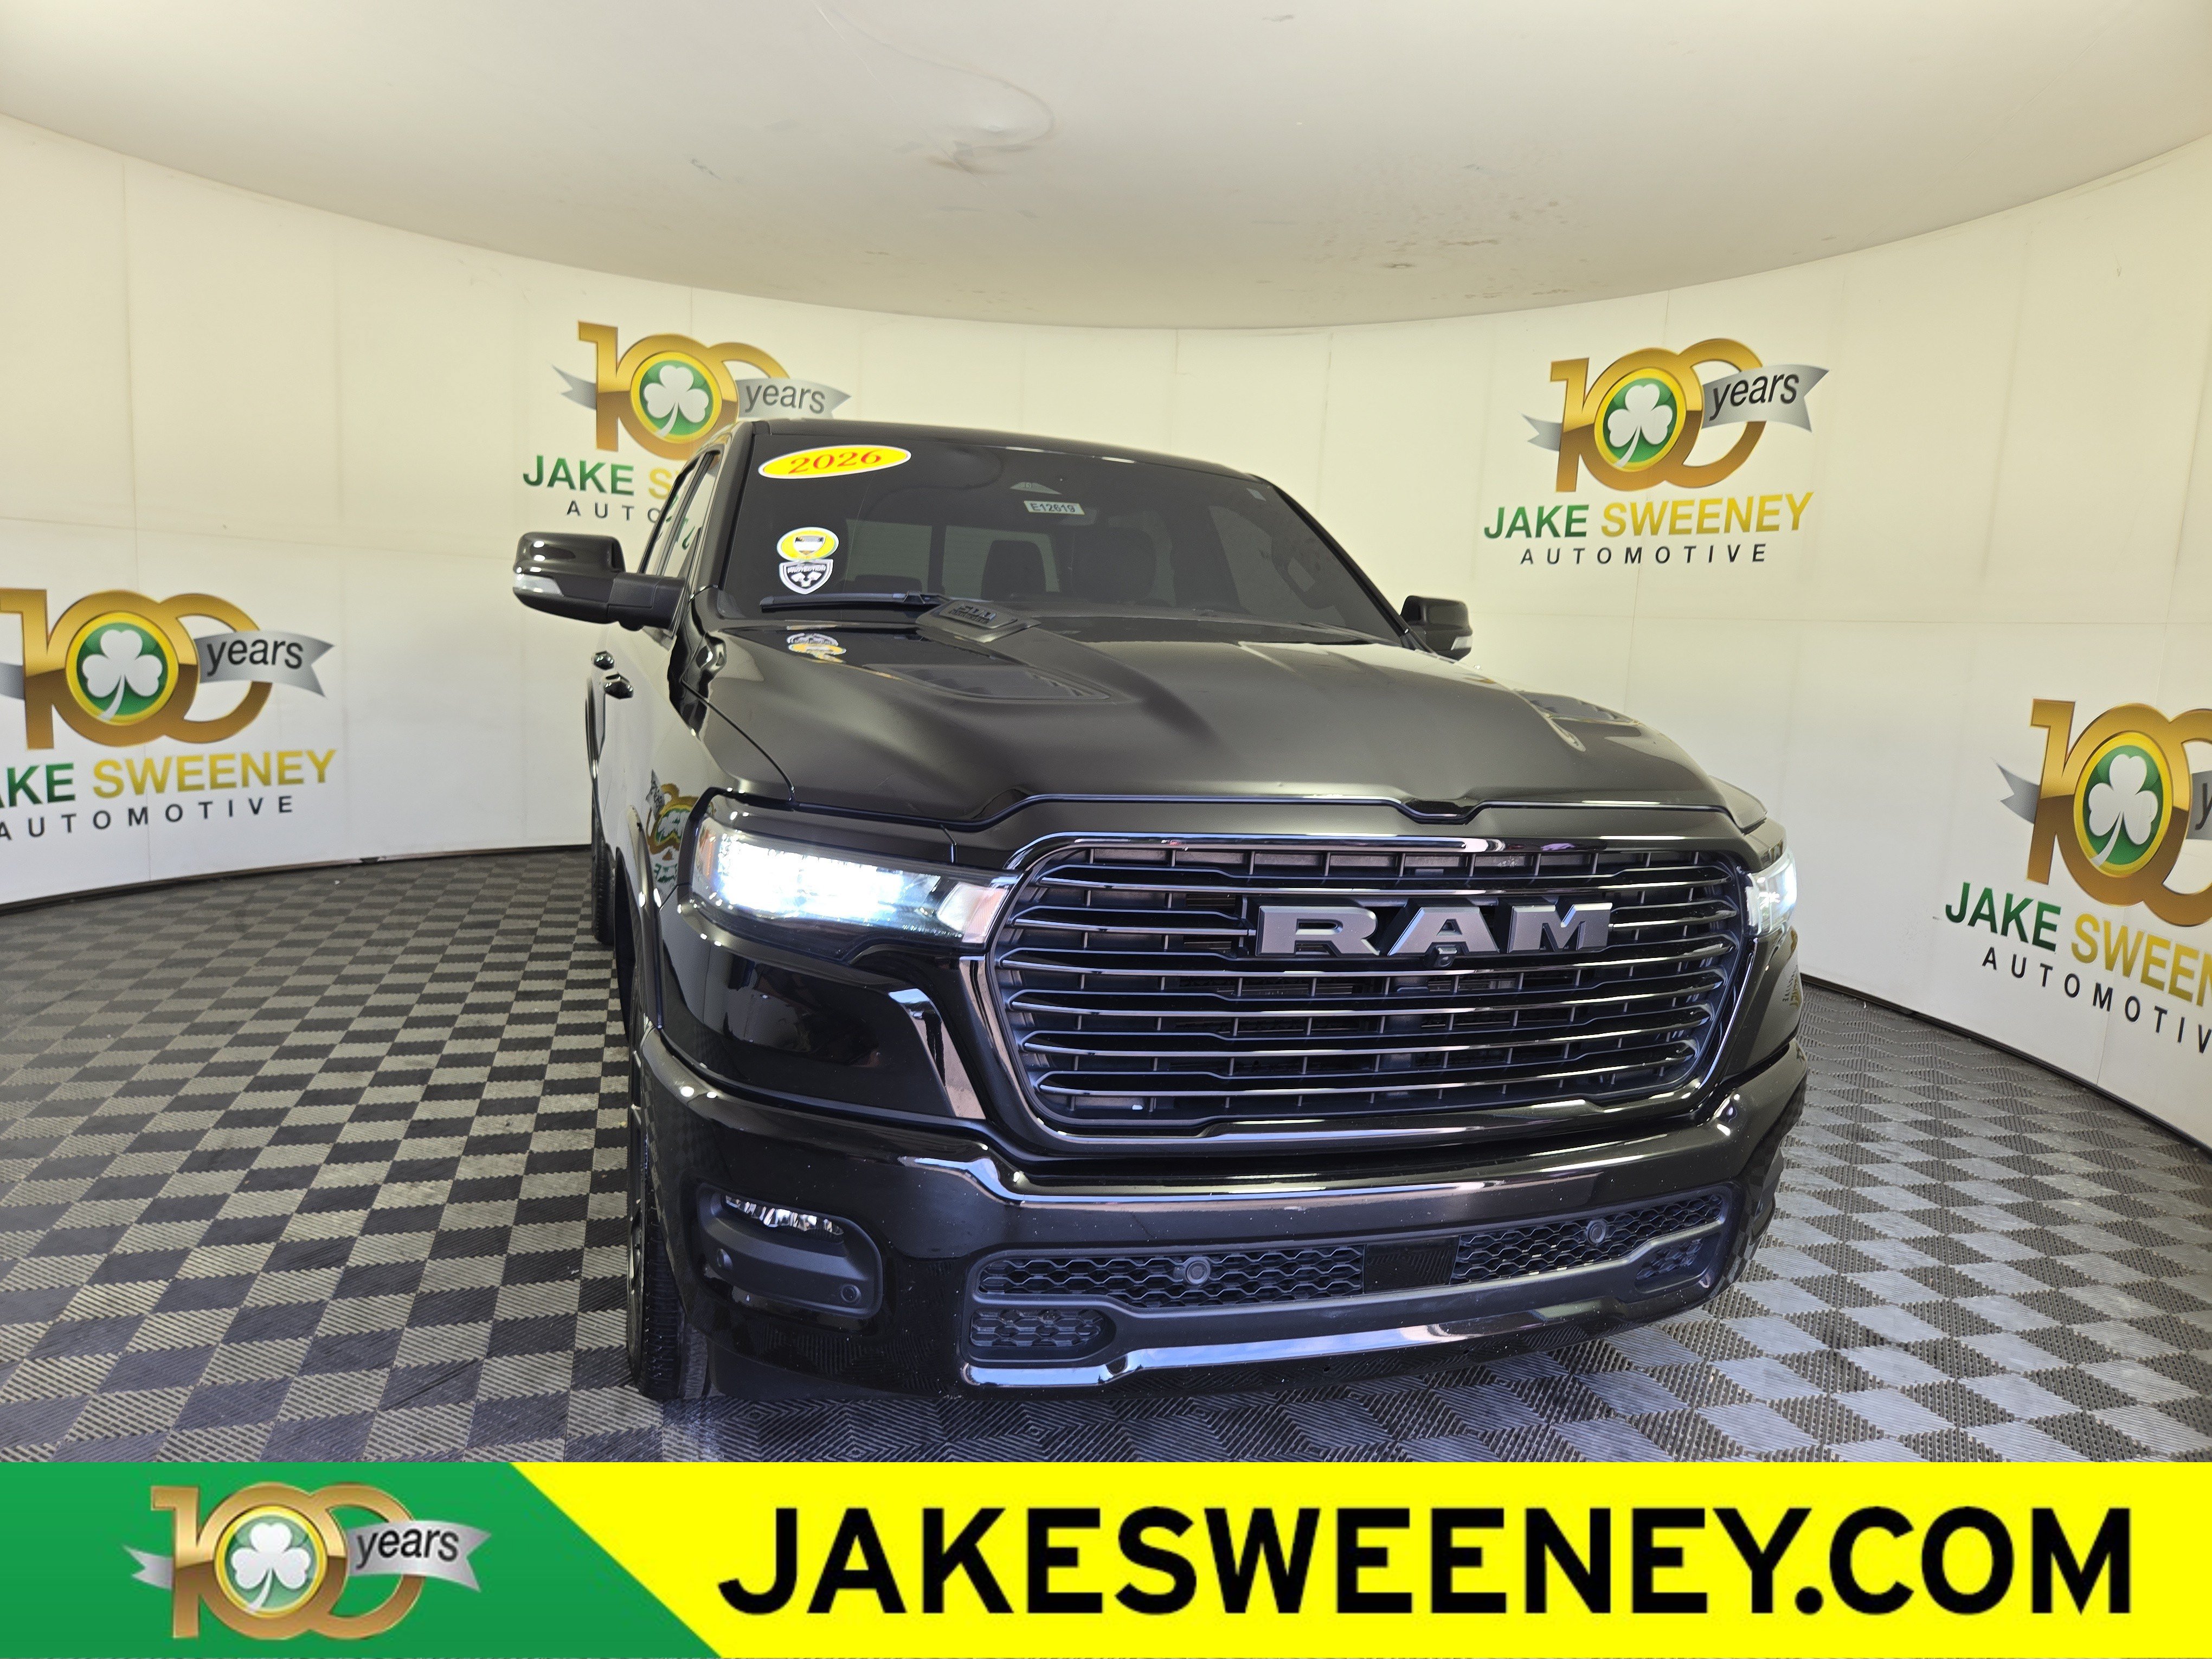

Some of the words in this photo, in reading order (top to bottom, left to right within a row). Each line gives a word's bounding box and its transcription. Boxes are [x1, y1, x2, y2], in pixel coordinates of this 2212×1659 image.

[744, 382, 826, 414] years
[1550, 338, 1767, 492] 100
[1709, 372, 1799, 421] years
[523, 455, 634, 496] JAKE
[788, 449, 883, 474] 2026
[1484, 505, 1590, 539] JAKE
[1601, 492, 1814, 538] SWEENEY
[1520, 544, 1767, 565] AUTOMOTIVE
[207, 638, 304, 677] years
[0, 762, 75, 809] KE
[92, 749, 336, 800] SWEENEY
[1255, 902, 1613, 957] RAM
[1945, 882, 2062, 953] JAKE
[1982, 947, 2212, 1053] AUTOMOTIV
